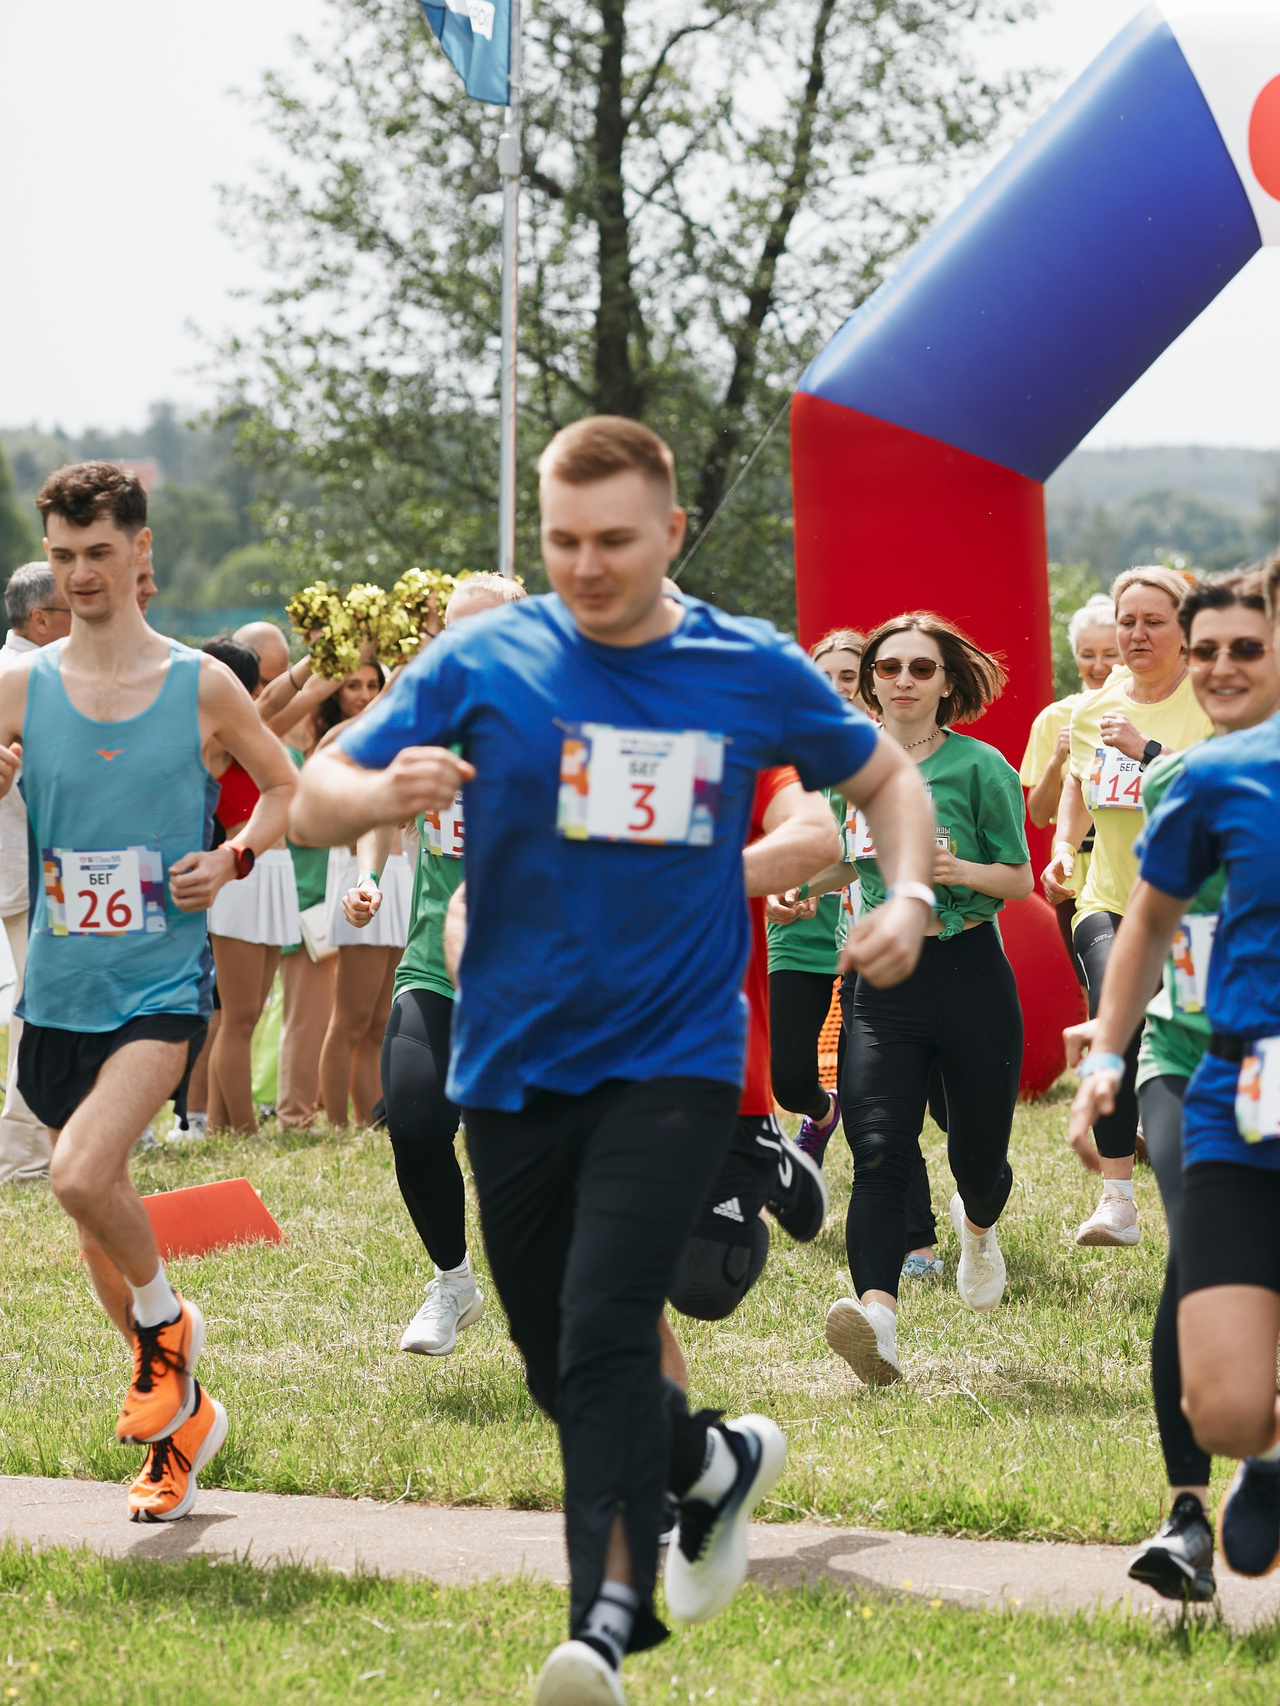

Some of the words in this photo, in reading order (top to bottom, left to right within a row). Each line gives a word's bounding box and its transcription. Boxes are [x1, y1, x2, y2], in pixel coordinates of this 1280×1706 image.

[1120, 763, 1136, 772] БЕГ
[1106, 775, 1143, 803] 14
[627, 783, 656, 831] 3
[89, 873, 112, 885] БЕГ
[77, 889, 132, 928] 26
